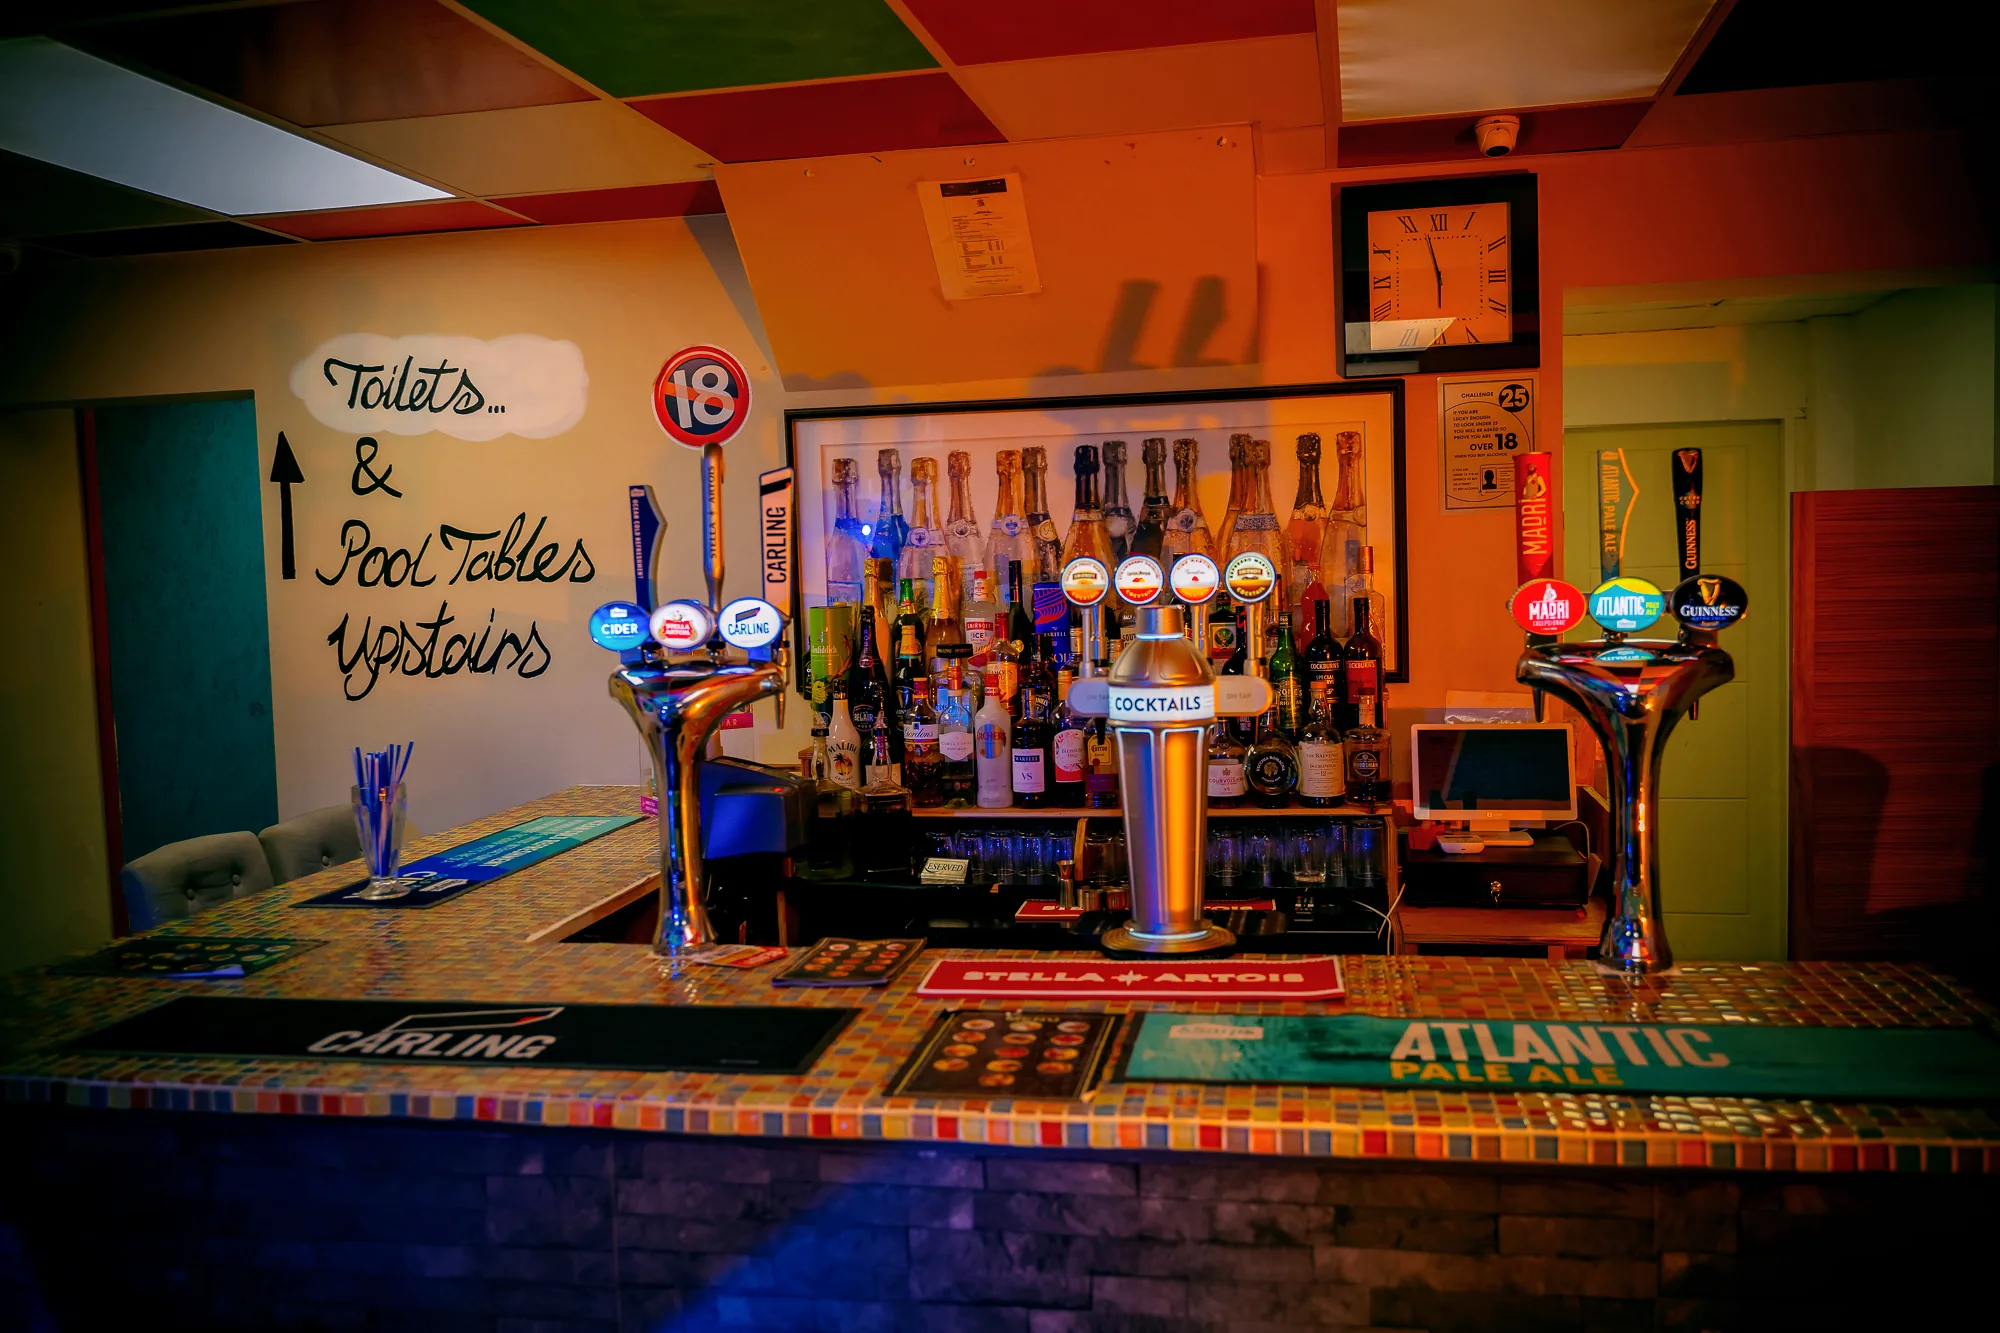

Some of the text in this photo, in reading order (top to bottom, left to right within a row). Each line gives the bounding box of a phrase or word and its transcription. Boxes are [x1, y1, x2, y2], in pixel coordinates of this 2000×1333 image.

[673, 364, 736, 430] 18
[1501, 388, 1528, 408] 25
[1470, 443, 1494, 451] OVER
[1495, 432, 1518, 450] 18
[351, 436, 403, 498] &
[706, 465, 717, 559] STELLA ARTOIS
[1601, 465, 1620, 553] ATLANTIC PALE ALE
[315, 511, 596, 588] Pool Tables
[766, 506, 787, 584] CARLING
[1685, 518, 1698, 570] GUINNESS
[1596, 596, 1645, 616] ATLANTIC
[1680, 604, 1739, 617] GUINNESS
[601, 623, 638, 635] CIDER
[728, 622, 770, 635] CARLING
[326, 601, 551, 701] Upstairs
[1115, 696, 1201, 712] COCKTAILS
[828, 740, 858, 754] MALIBU
[1021, 772, 1033, 780] VS
[925, 862, 964, 873] ESERVED
[962, 971, 1304, 984] STELLA ARTOIS
[307, 1030, 556, 1059] CARLING
[1390, 1022, 1731, 1068] ATLANTIC
[1390, 1060, 1624, 1086] PALE ALE
